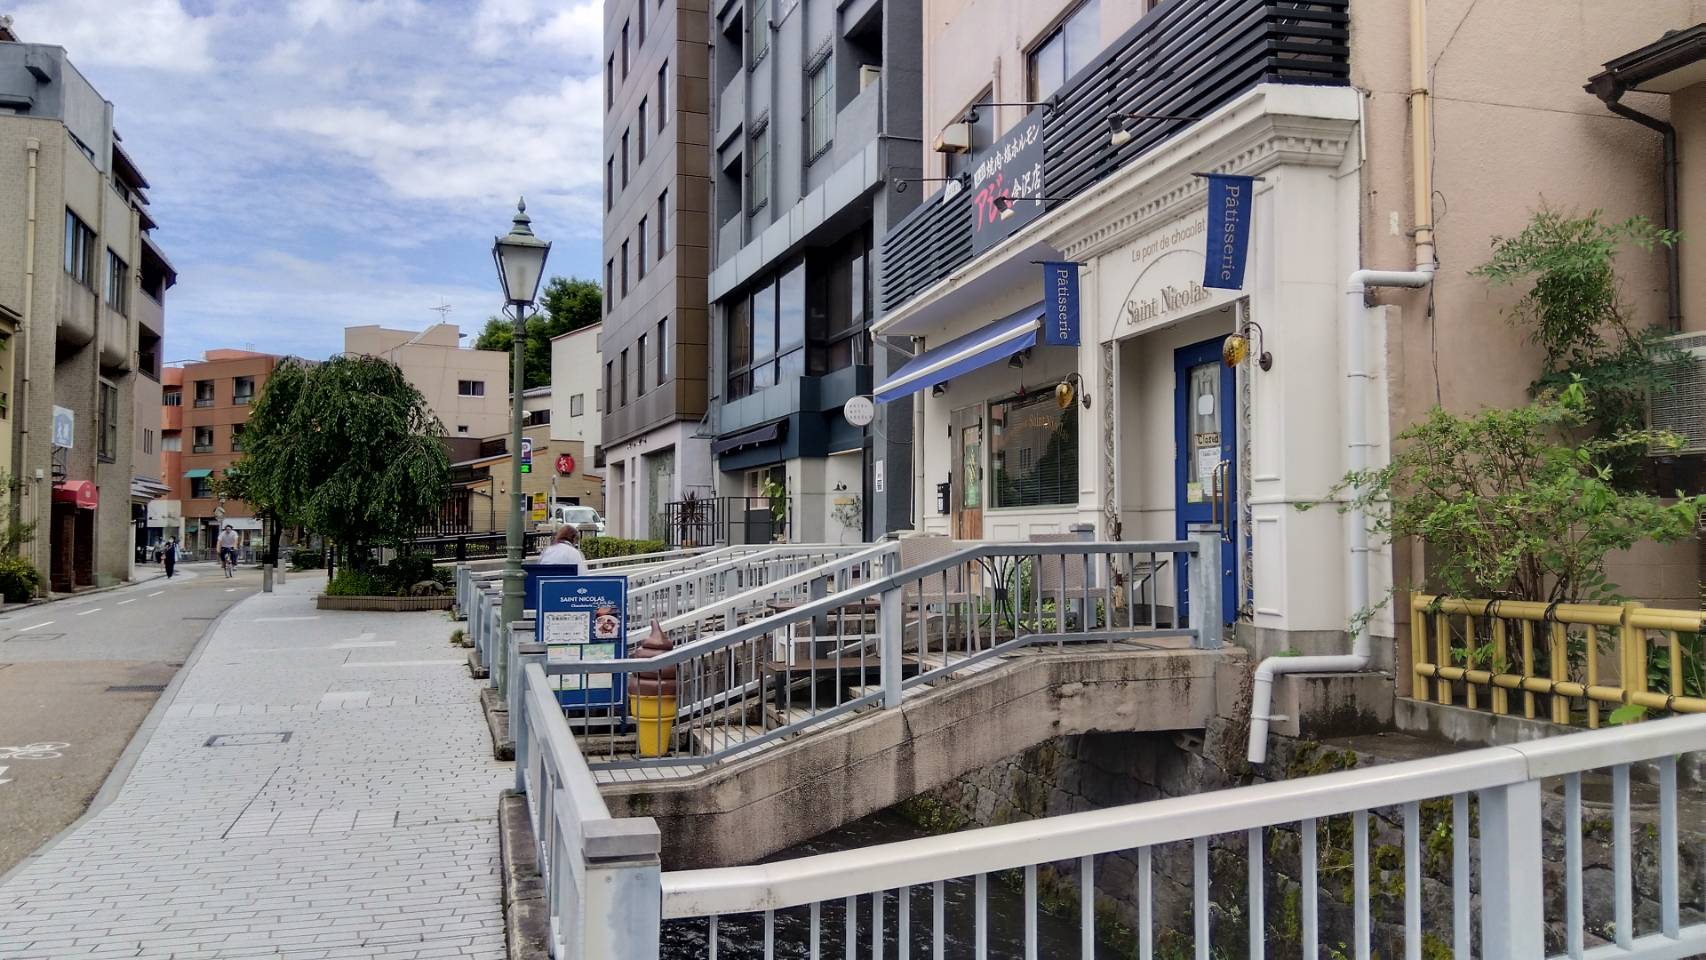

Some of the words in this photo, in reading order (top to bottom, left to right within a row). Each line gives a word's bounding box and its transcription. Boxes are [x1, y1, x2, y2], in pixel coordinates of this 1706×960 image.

[1141, 243, 1158, 264] pont
[1160, 236, 1170, 249] de
[1171, 219, 1205, 245] chocolat
[1221, 184, 1241, 281] Pâtisserie
[1056, 269, 1070, 340] Pâtisserie
[1127, 298, 1158, 327] Saint
[521, 443, 531, 457] P
